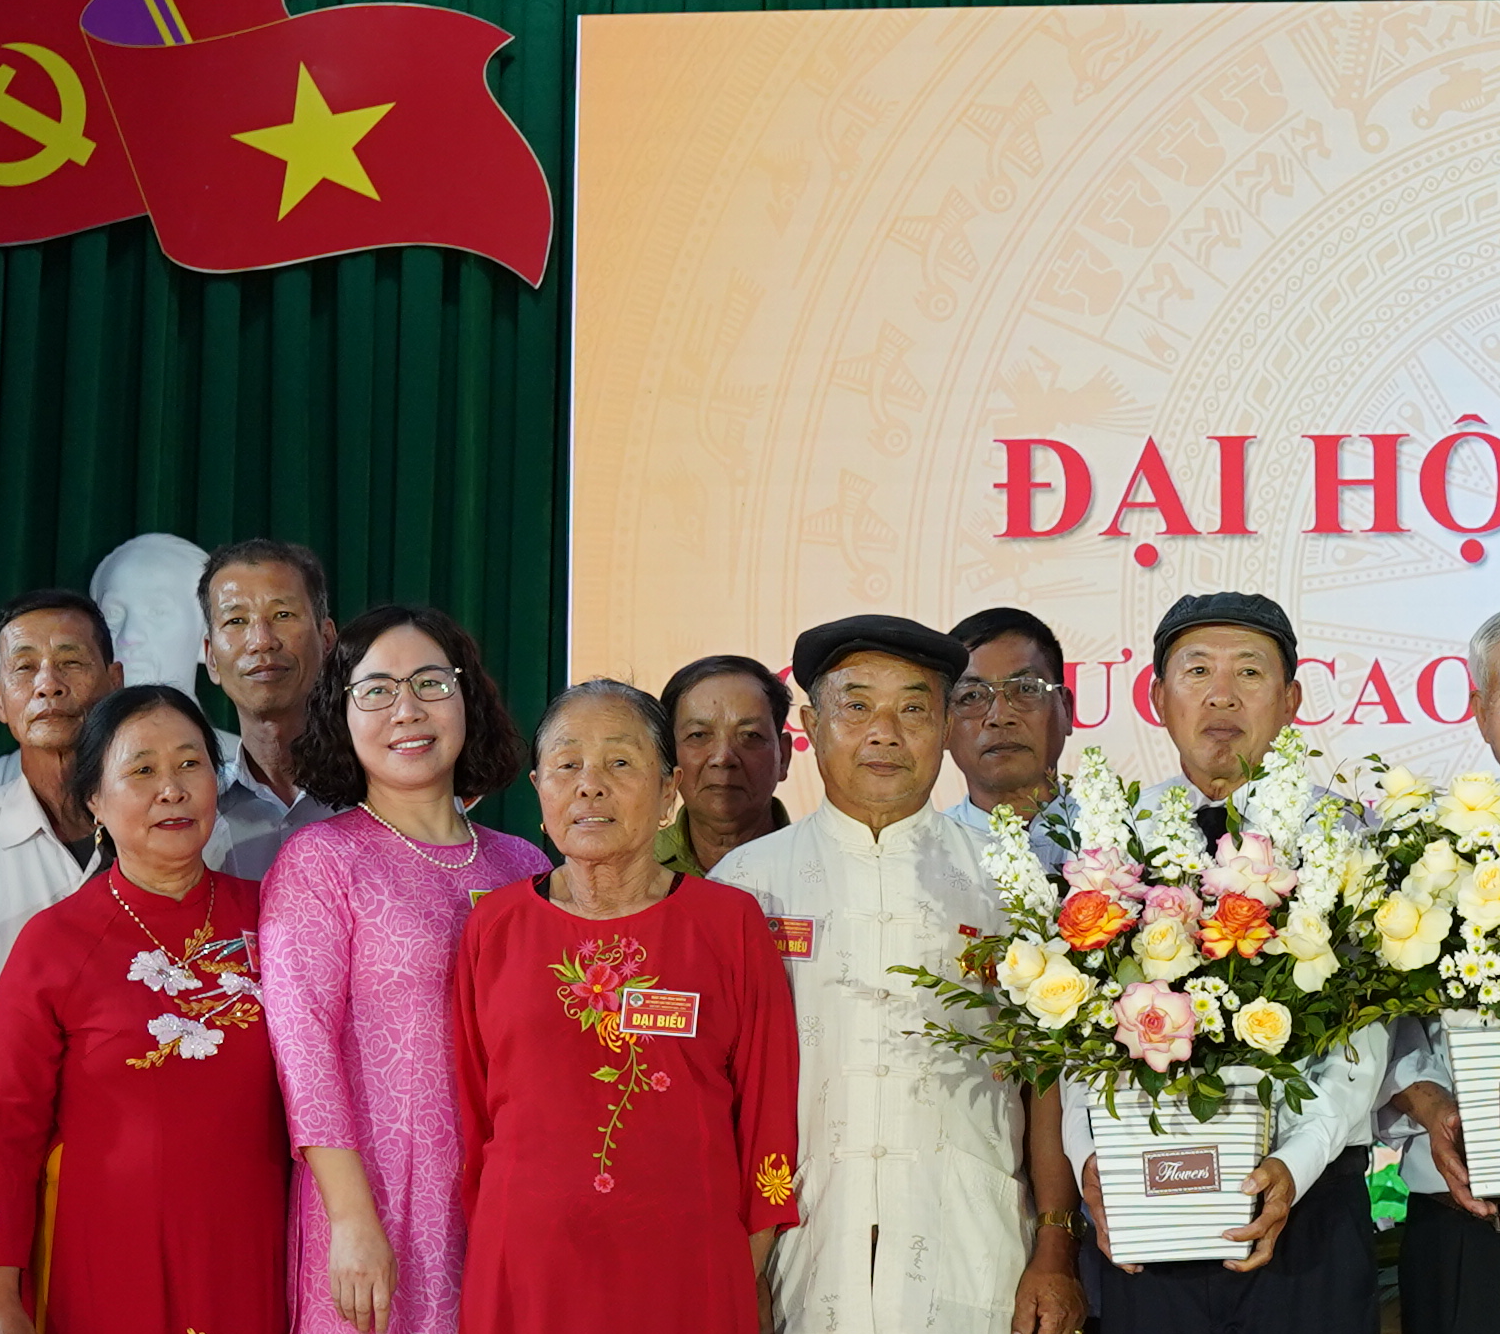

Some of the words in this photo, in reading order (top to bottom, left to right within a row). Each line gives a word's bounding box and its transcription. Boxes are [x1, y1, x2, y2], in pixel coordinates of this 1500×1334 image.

[993, 433, 1258, 567] ĐẠI
[656, 1011, 687, 1029] BIỂU
[1155, 1160, 1210, 1183] Flowers
